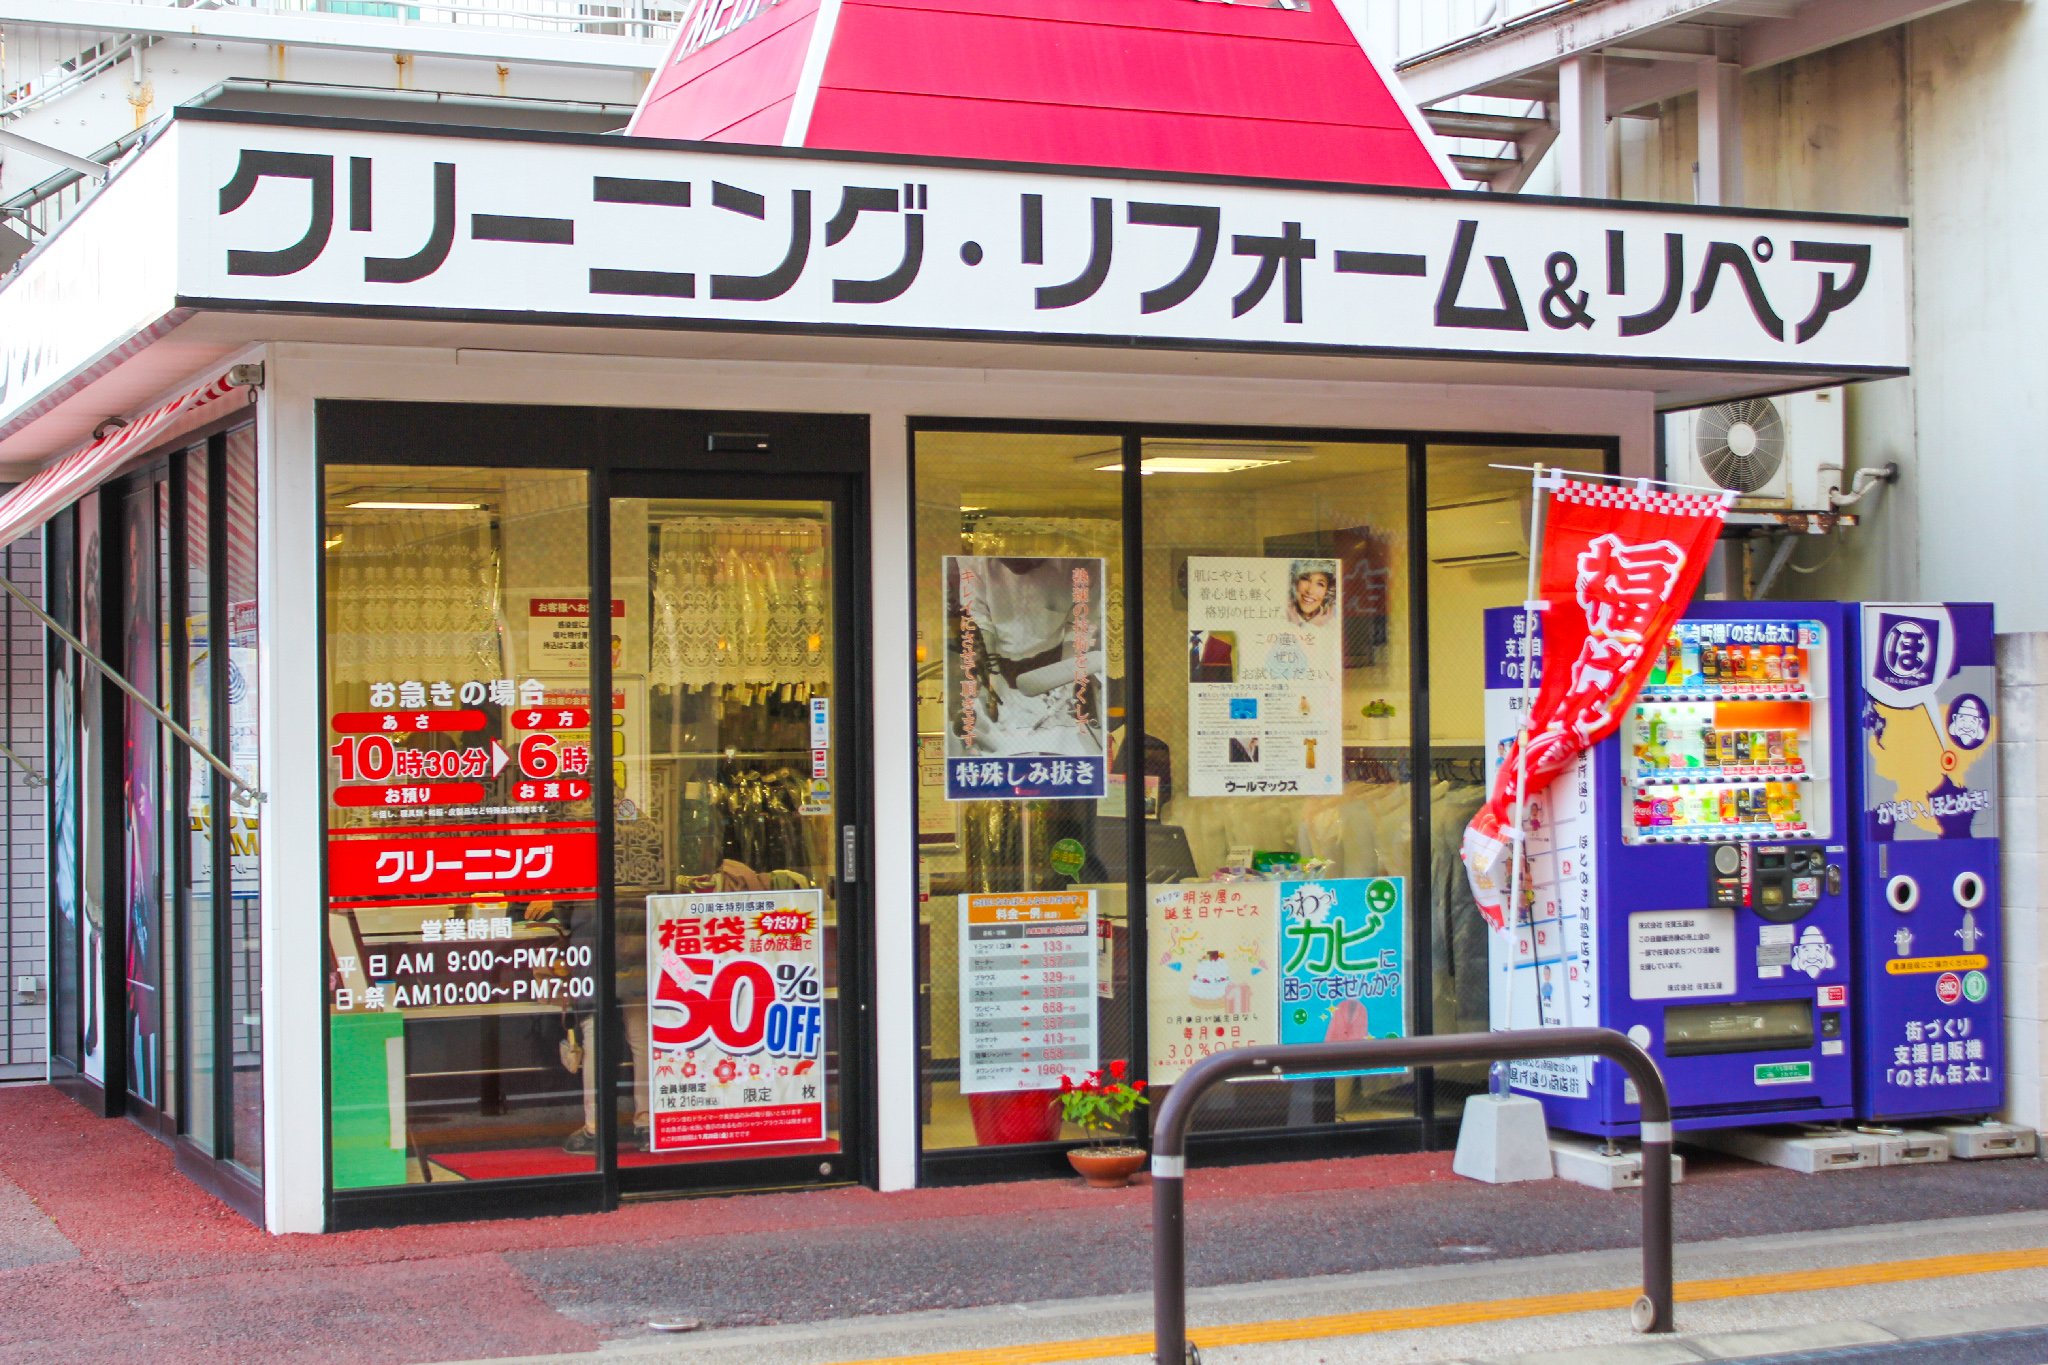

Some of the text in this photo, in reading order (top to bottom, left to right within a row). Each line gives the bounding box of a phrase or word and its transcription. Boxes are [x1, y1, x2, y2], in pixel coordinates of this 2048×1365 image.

[219, 149, 1872, 344] クリーニング・リフォーム&リペア
[1193, 569, 1268, 583] 肌にやさしく
[1199, 587, 1273, 601] 着心地も軽く
[538, 602, 590, 613] お客様へお
[1204, 605, 1286, 619] 格別の仕上げ。
[1255, 632, 1316, 646] この違いを
[1273, 651, 1299, 664] ぜひ
[1241, 668, 1335, 681] お試しください。
[382, 714, 430, 731] あさ
[526, 711, 575, 728] 夕方
[331, 733, 490, 782] 10時30分
[517, 732, 590, 780] 6時
[955, 760, 1096, 788] 特殊しみ抜き
[519, 783, 584, 799] お渡し
[1224, 780, 1299, 793] ウールマックス
[384, 787, 432, 804] お預り
[375, 844, 554, 884] クリーニング
[1183, 888, 1242, 905] 明治屋の
[690, 900, 775, 915] 90周年特別感謝祭
[1164, 904, 1260, 921] 誕生日サービス
[420, 916, 514, 943] 営業時間
[657, 914, 745, 955] 福袋
[1893, 932, 1914, 944] カン
[1953, 927, 1984, 940] ペット
[749, 935, 812, 953] 詰め放題で
[337, 955, 388, 979] 平日
[395, 952, 435, 975] AM
[1283, 972, 1401, 1001] 困ってませんか?
[335, 987, 385, 1010] 日・祭
[766, 1003, 821, 1054] OFF
[1905, 1017, 1972, 1041] 街づくり
[1893, 1038, 1984, 1065] 支援自販機
[1510, 1067, 1579, 1094] 県庁通り商店街
[1885, 1061, 1991, 1087] 「のまん缶太」
[659, 1082, 816, 1103] 会員様限定 限定 枚
